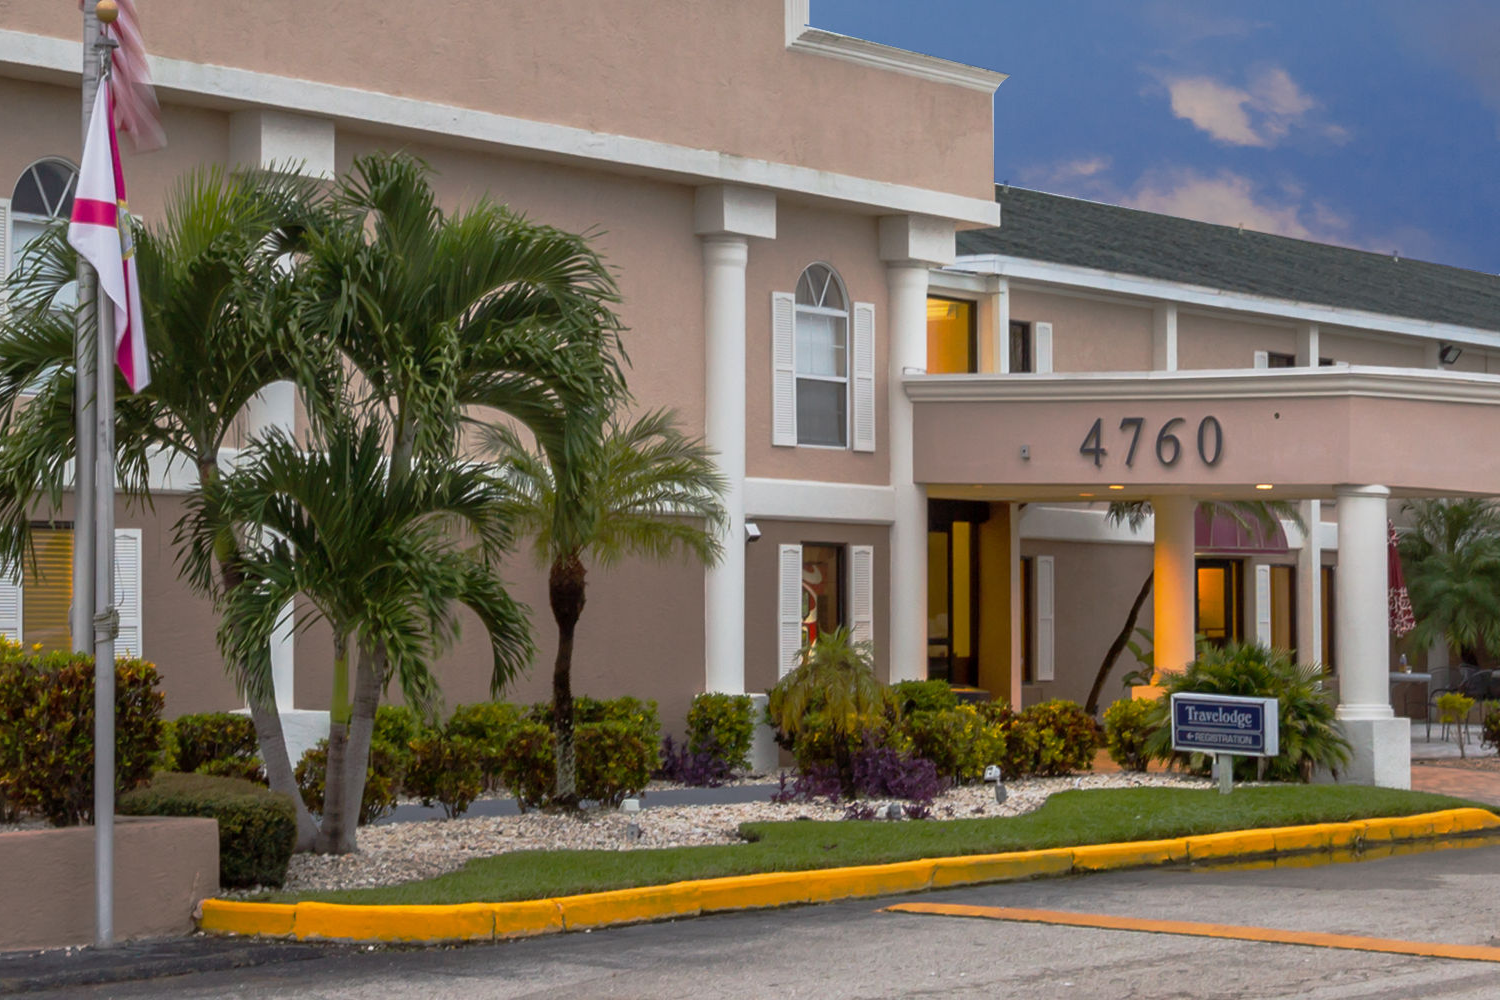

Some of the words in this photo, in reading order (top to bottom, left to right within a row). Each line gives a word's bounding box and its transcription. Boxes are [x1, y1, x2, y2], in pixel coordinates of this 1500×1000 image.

[1079, 415, 1223, 468] 4760
[1185, 705, 1252, 729] Travelodge
[1194, 732, 1252, 745] REGISTRATION
